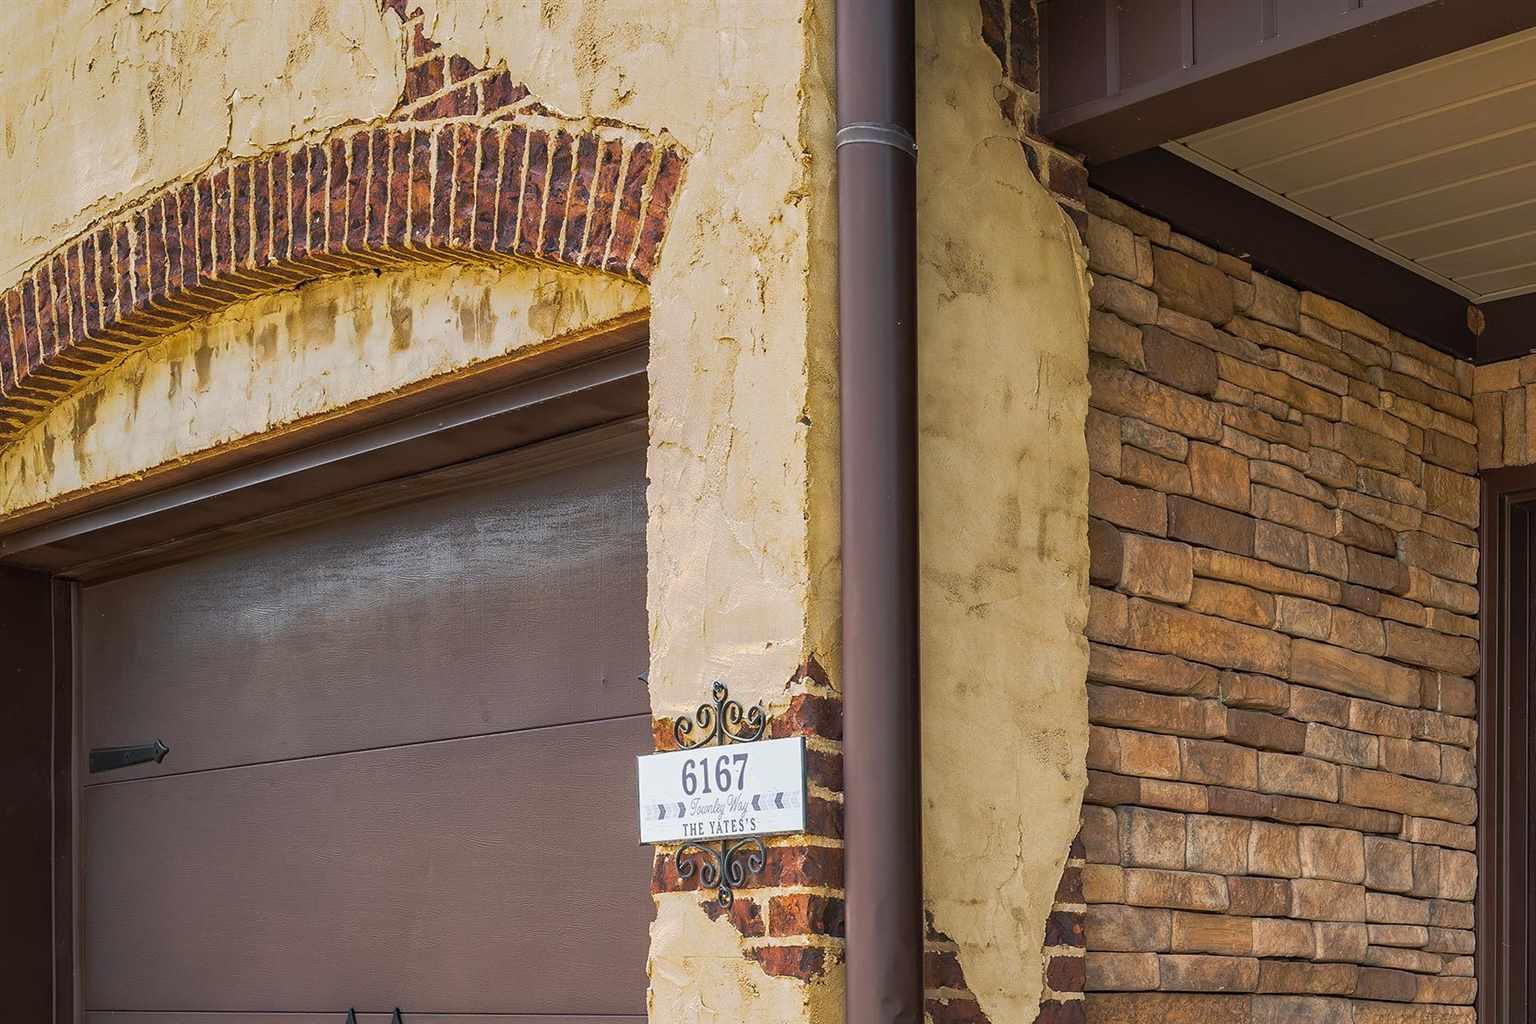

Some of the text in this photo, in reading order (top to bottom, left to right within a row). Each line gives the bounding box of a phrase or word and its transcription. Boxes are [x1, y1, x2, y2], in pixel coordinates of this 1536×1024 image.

[681, 753, 748, 796] 6167
[727, 793, 749, 819] Way
[683, 817, 757, 837] THE YATES'S
